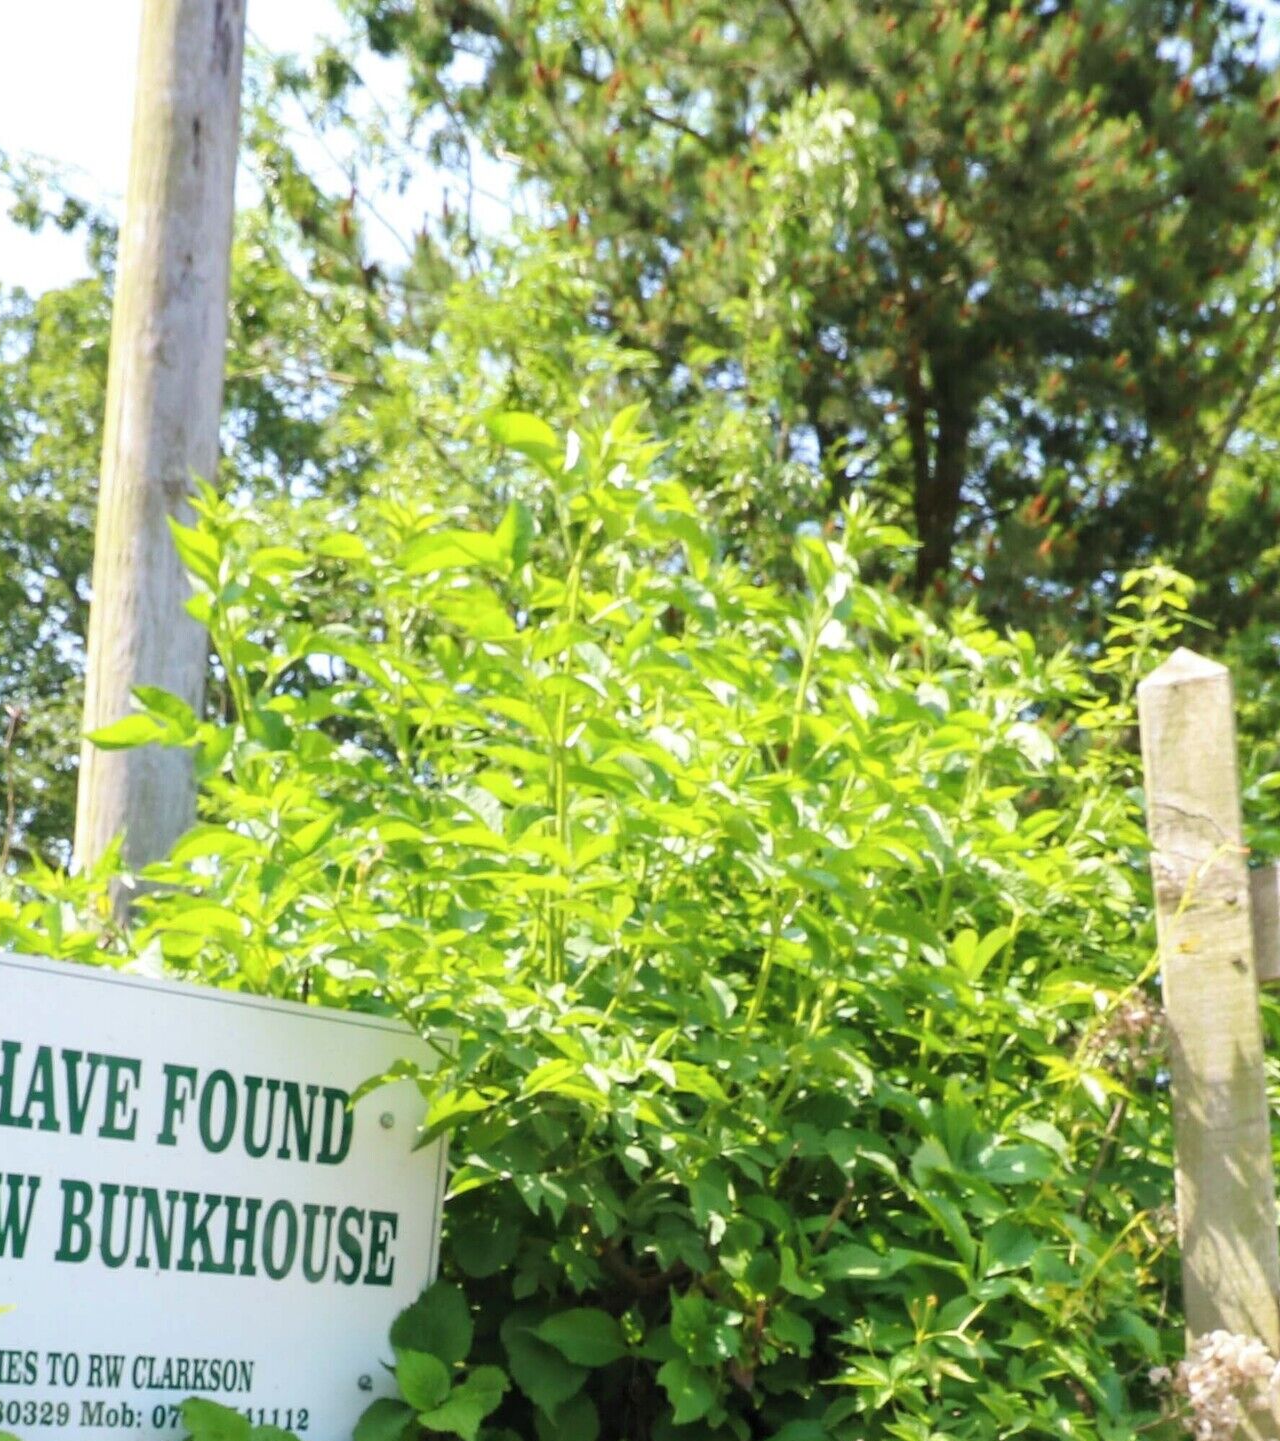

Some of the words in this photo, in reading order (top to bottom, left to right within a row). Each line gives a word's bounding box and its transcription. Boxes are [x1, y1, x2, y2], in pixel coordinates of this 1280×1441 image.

[156, 1062, 354, 1165] FOUND
[54, 1178, 399, 1287] BUNKHOUSE
[46, 1351, 79, 1386] TO
[86, 1354, 125, 1388] RW
[131, 1355, 255, 1392] CLARKSON
[78, 1400, 143, 1429] Mob:
